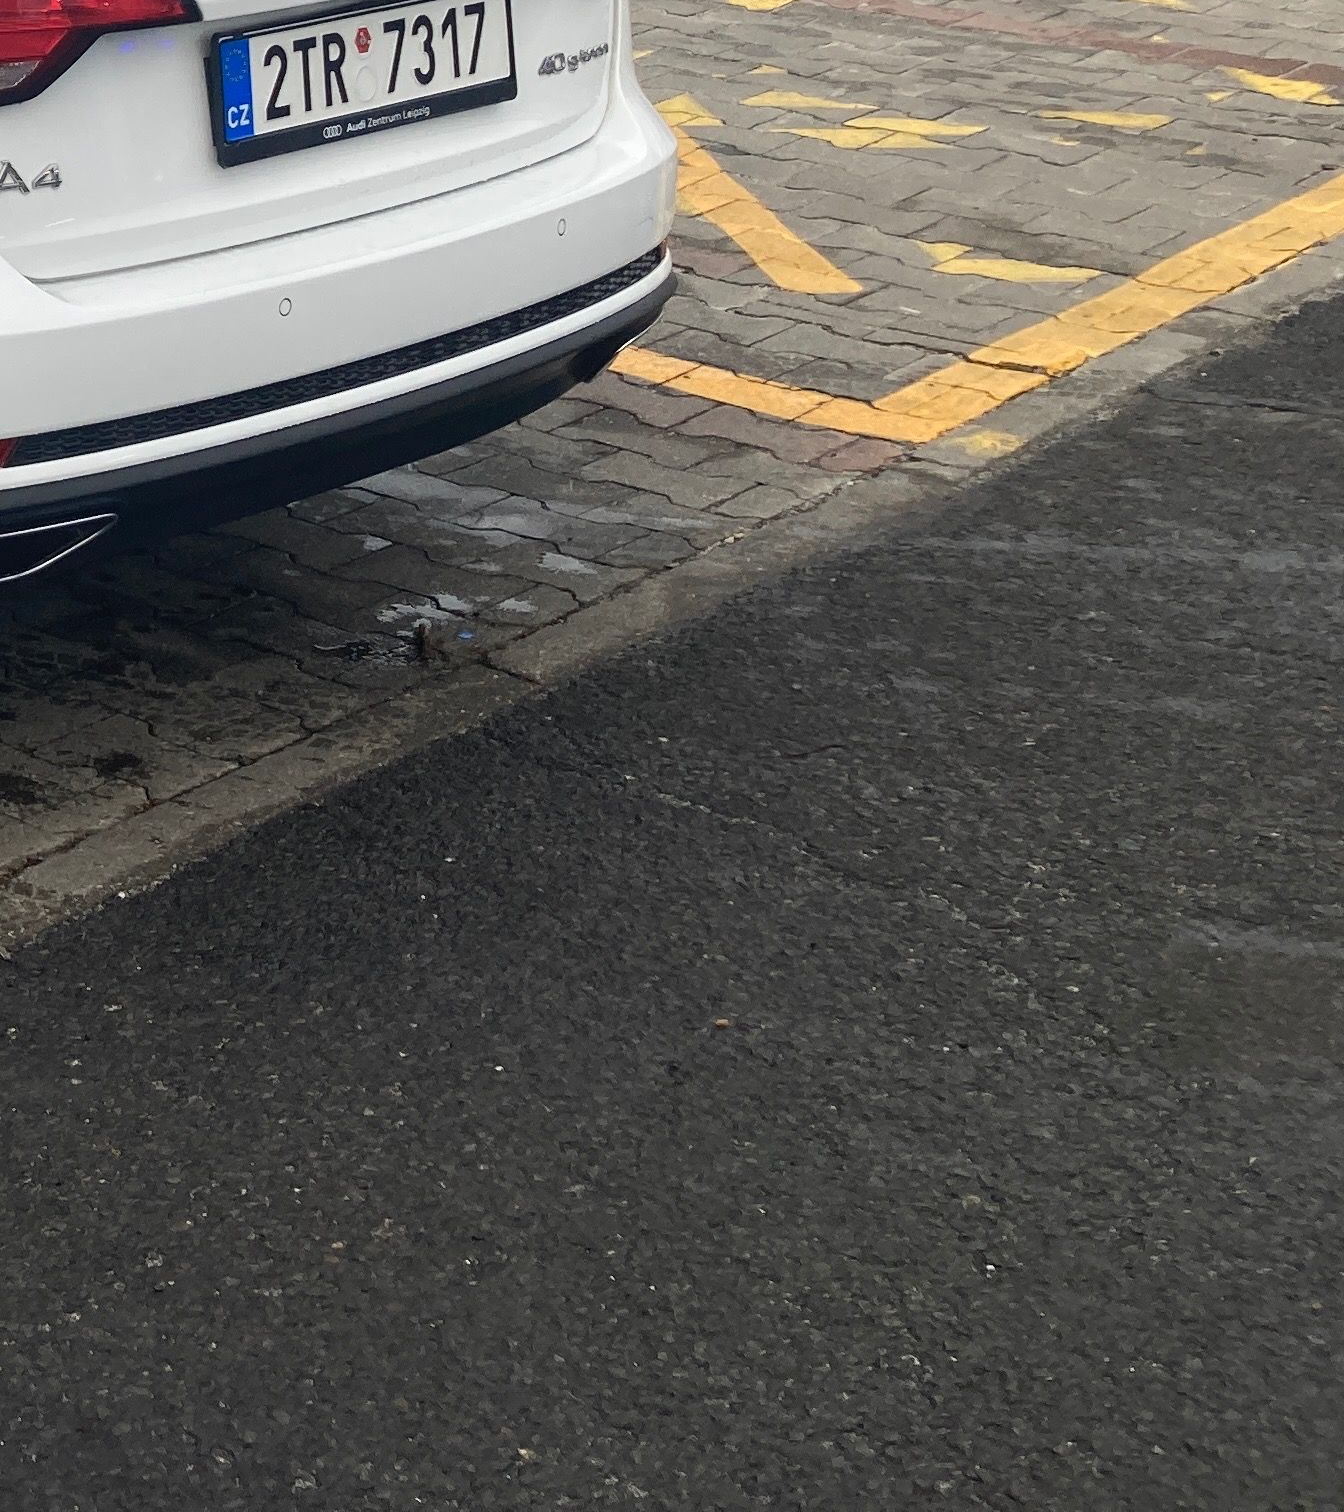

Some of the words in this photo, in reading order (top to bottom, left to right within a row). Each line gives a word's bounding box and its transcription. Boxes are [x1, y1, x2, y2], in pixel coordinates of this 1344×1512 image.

[263, 32, 349, 121] 2TR
[383, 1, 485, 94] 7317
[227, 105, 251, 129] CZ
[346, 119, 366, 133] Audi
[367, 113, 402, 128] Zentrum
[402, 106, 430, 120] Leipzig
